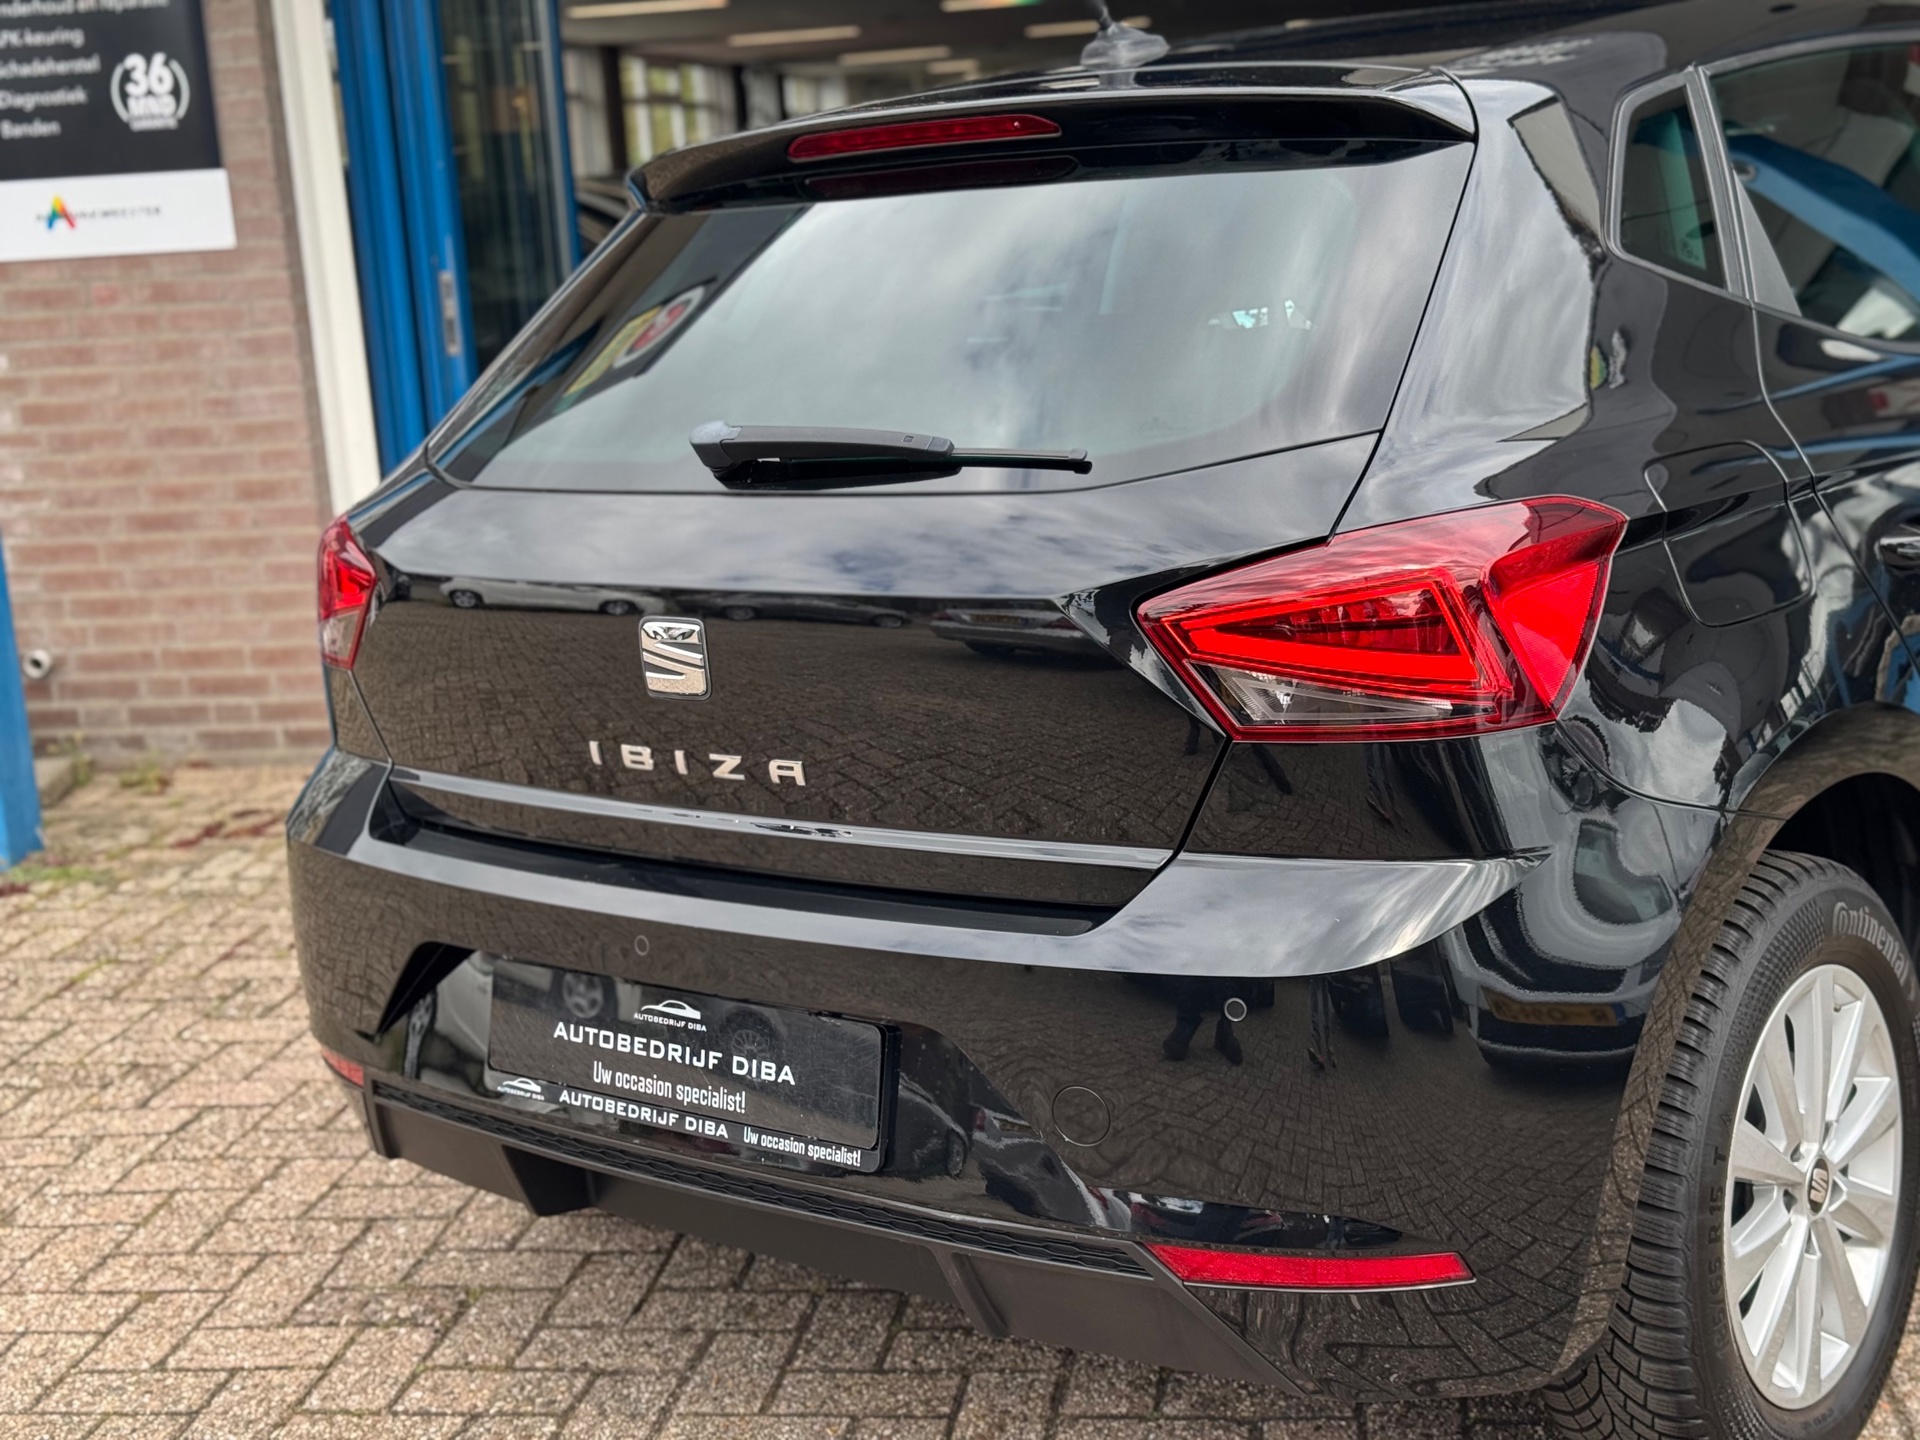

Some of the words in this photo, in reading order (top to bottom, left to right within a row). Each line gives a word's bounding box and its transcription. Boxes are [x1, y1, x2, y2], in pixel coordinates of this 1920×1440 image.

[0, 0, 75, 17] nderhoud
[123, 52, 175, 96] 36
[589, 740, 806, 786] IBIZA
[1832, 901, 1909, 987] Continental
[634, 1012, 687, 1028] AUTOBEDRIJF
[687, 1022, 707, 1032] DIBA
[553, 1021, 723, 1070] AUTOBEDRIJF
[732, 1055, 796, 1086] DIBA
[593, 1060, 612, 1085] Uw
[615, 1075, 672, 1099] occasion
[675, 1083, 746, 1115] specialist!
[558, 1089, 680, 1127] AUTOBEDRIJF
[684, 1116, 729, 1139] DIBA
[743, 1126, 758, 1145] Uw
[760, 1137, 805, 1155] occasion
[807, 1145, 861, 1168] specialist!
